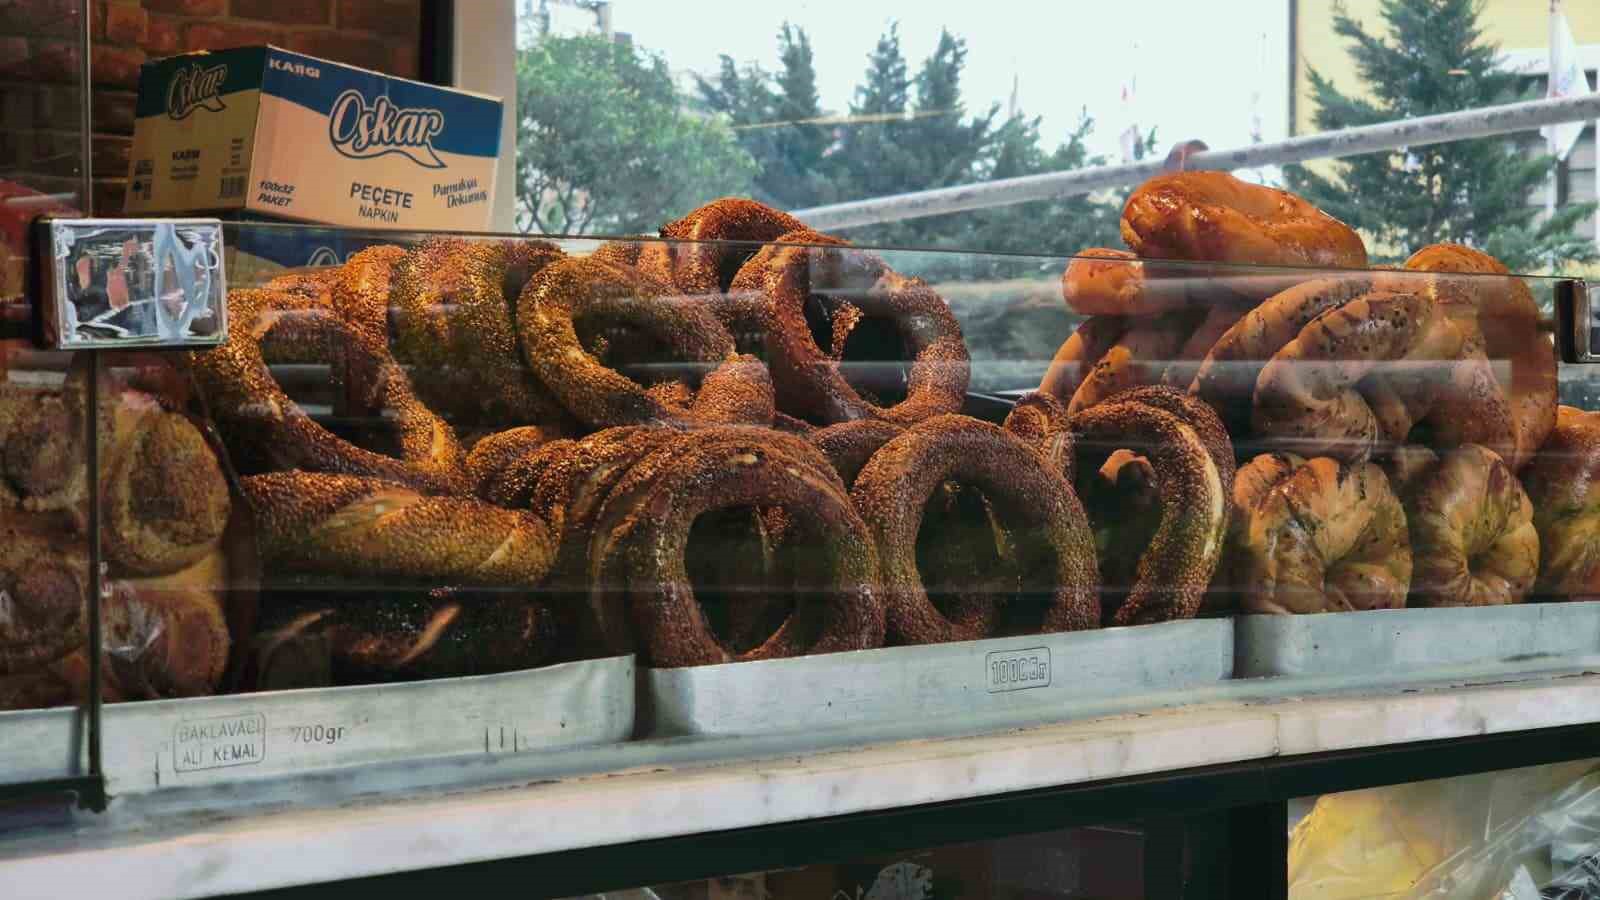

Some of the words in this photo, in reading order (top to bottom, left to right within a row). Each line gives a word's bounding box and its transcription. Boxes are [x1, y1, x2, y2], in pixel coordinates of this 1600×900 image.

[168, 64, 227, 117] Oskar
[329, 89, 445, 161] Oskar
[257, 193, 293, 207] PAKET
[350, 182, 413, 208] PEÇETE
[358, 204, 399, 223] NAPKIN
[213, 743, 257, 762] KEMAL
